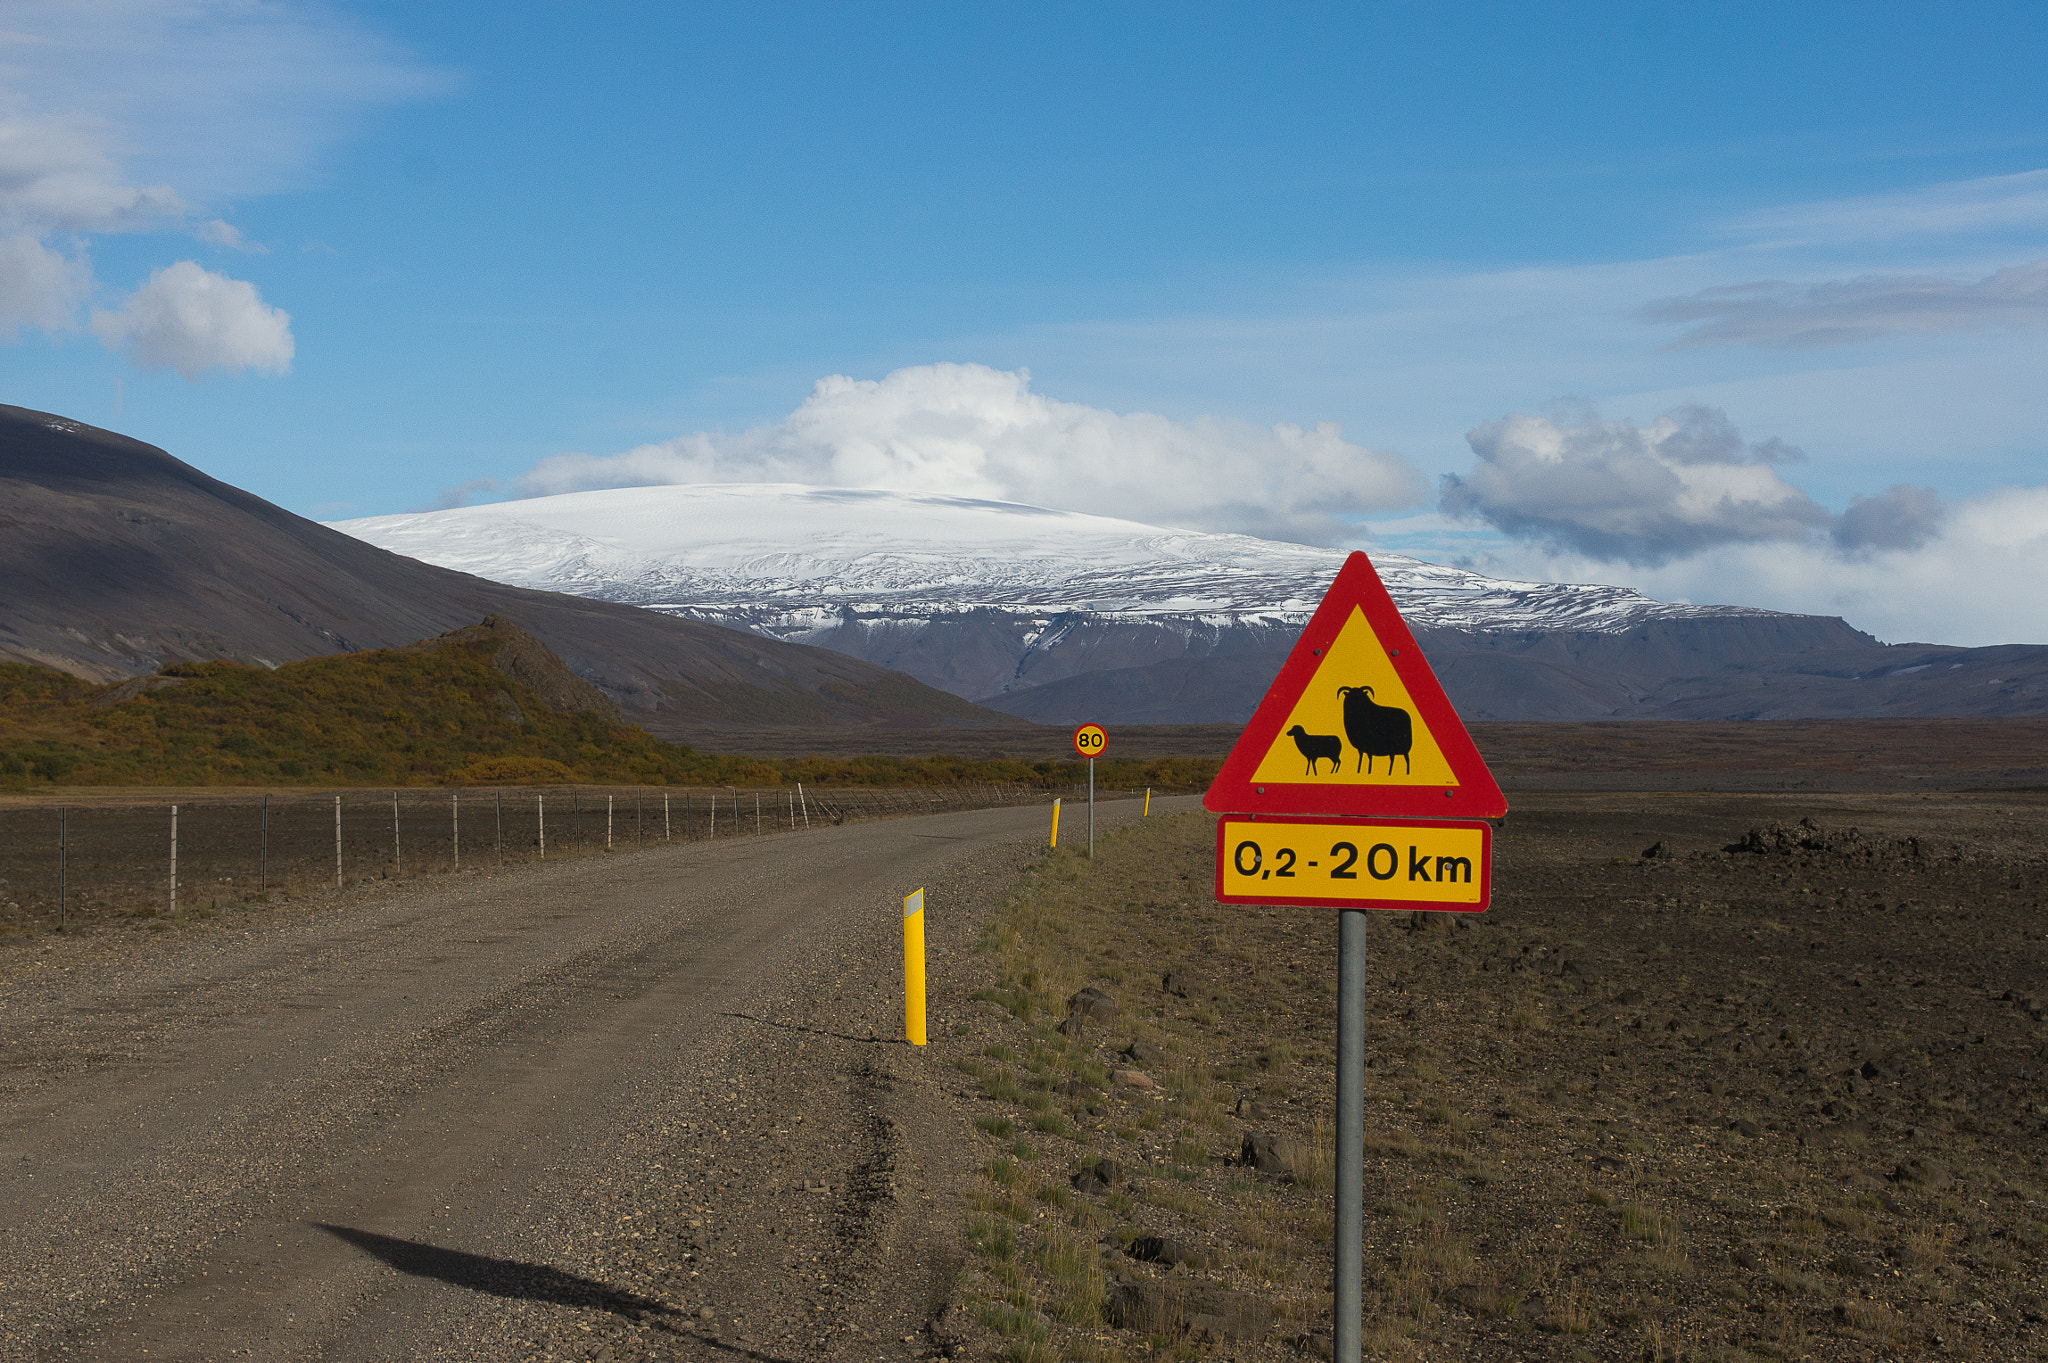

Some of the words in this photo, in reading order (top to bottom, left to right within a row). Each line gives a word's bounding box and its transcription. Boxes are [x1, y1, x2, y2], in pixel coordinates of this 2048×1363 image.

[1079, 733, 1103, 747] 80
[1234, 840, 1297, 881] 0,2
[1329, 841, 1399, 881] 20
[1408, 845, 1472, 883] km
